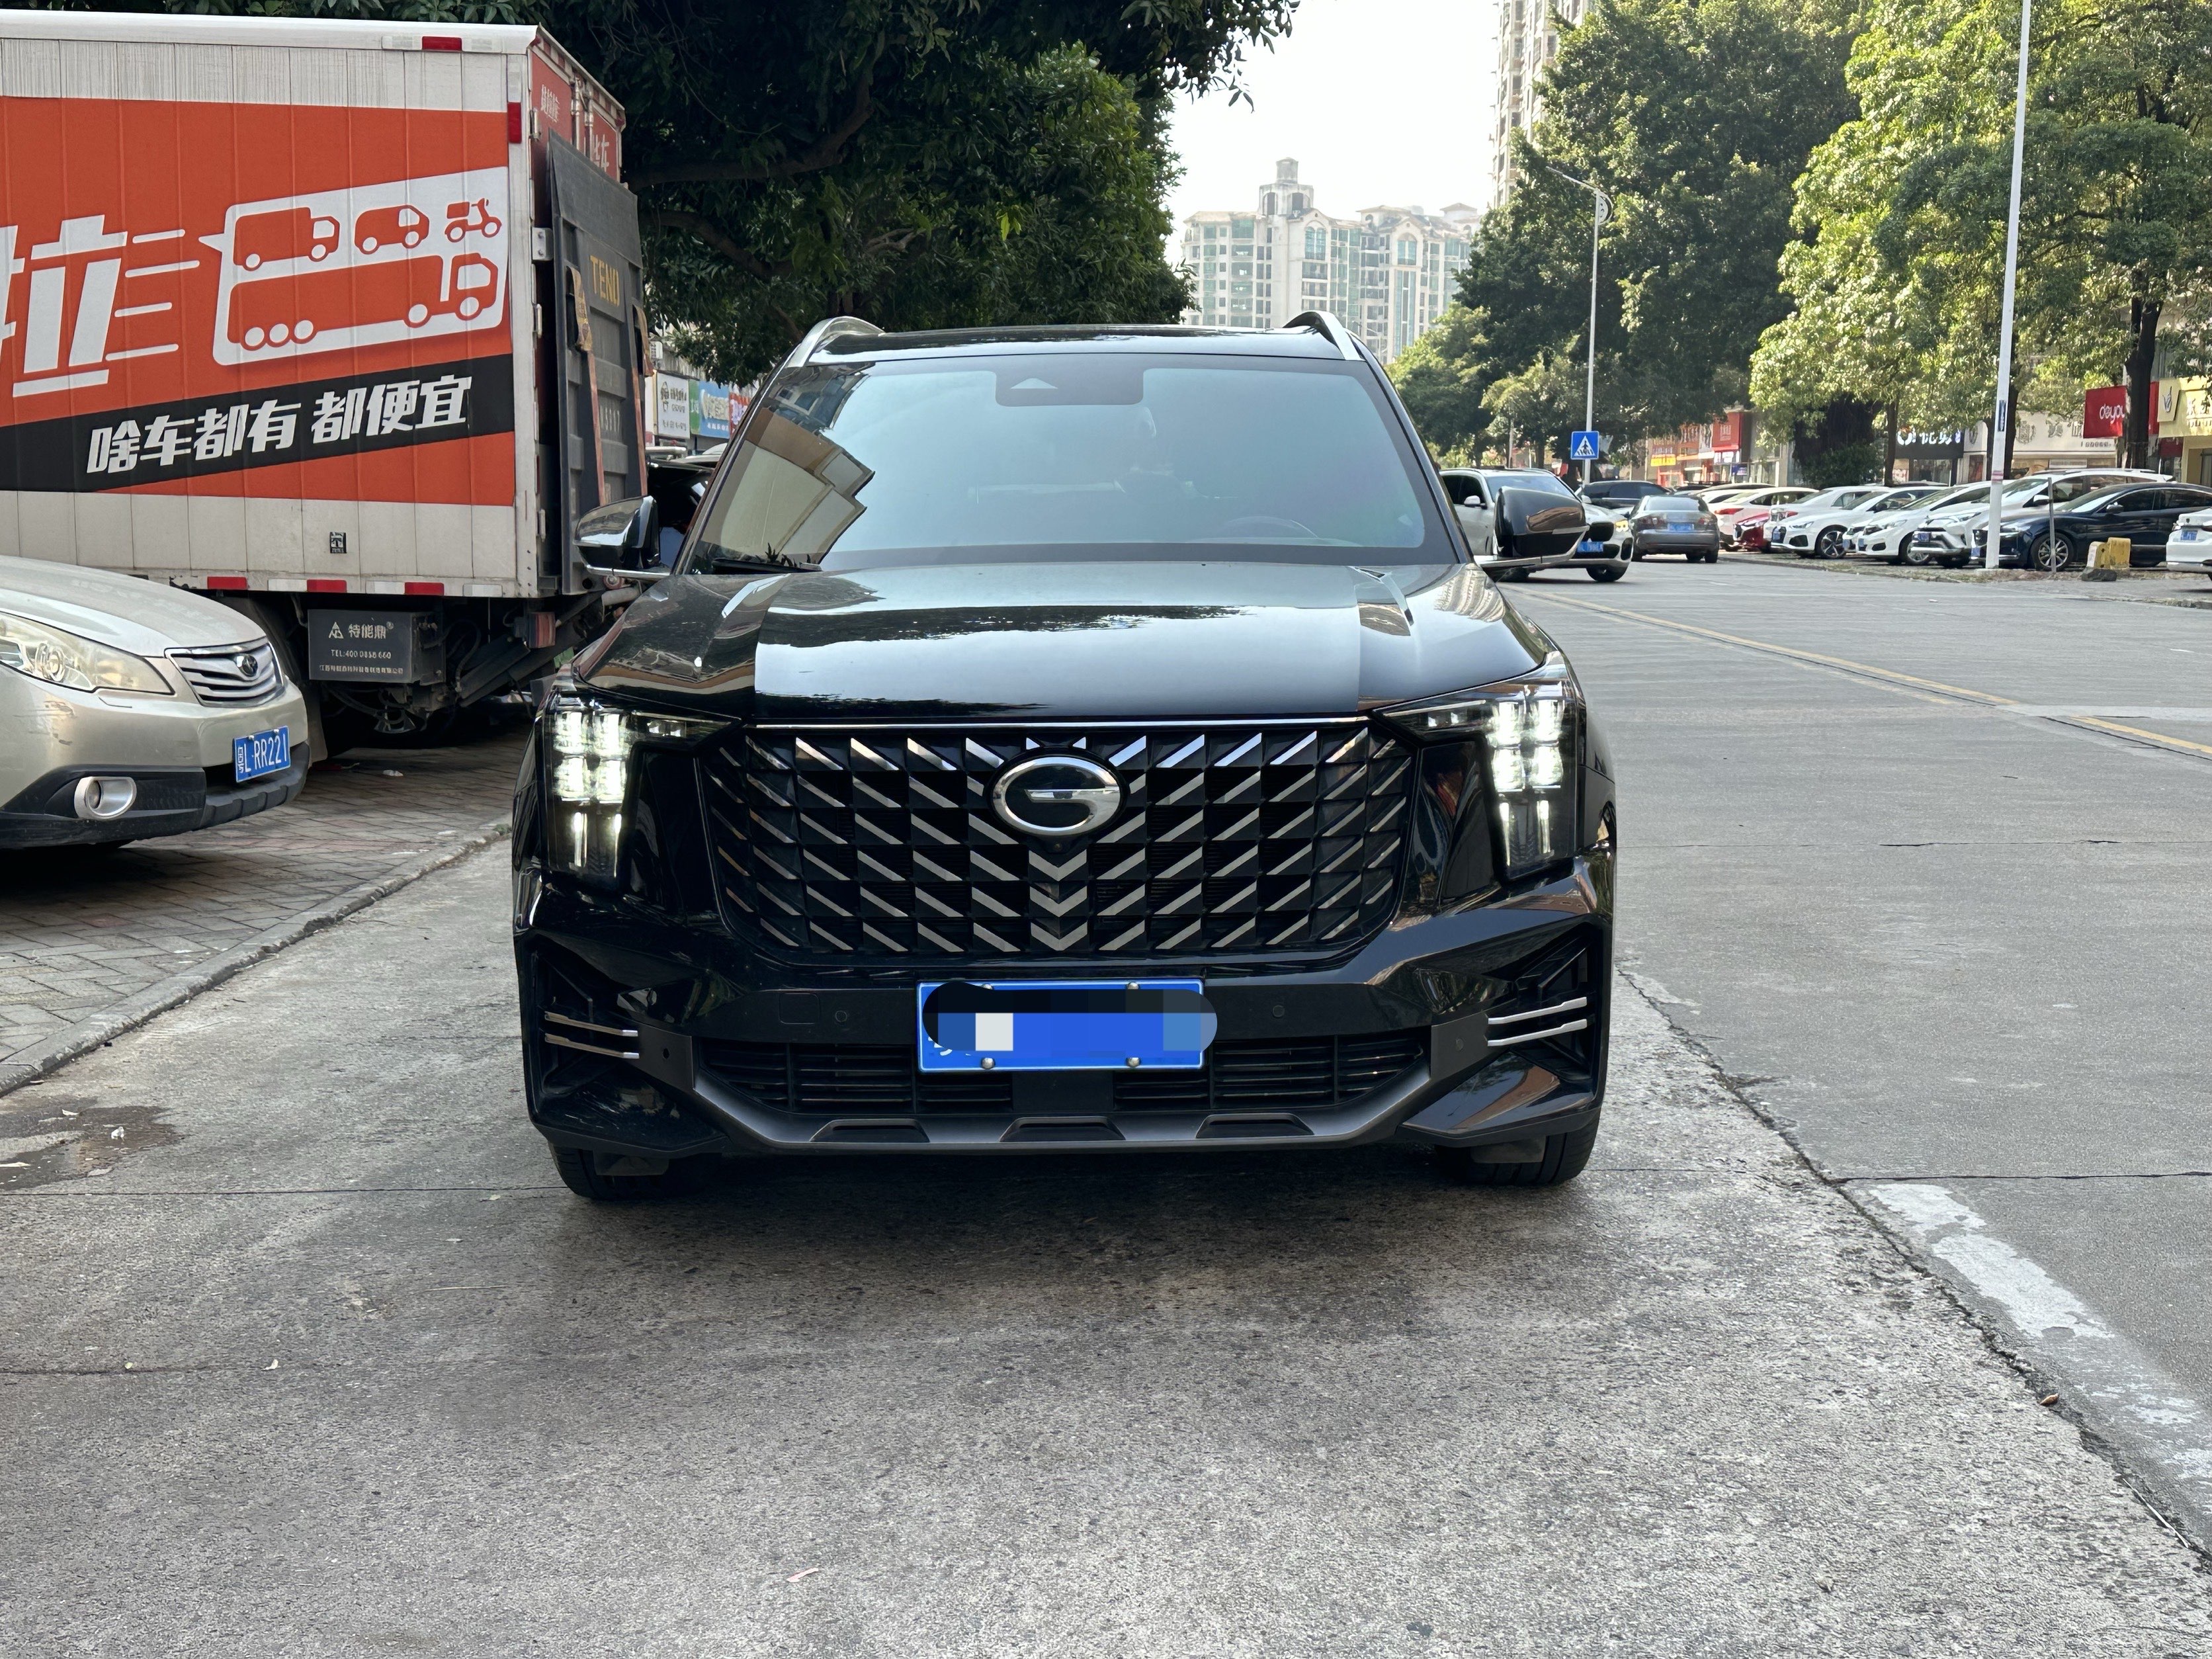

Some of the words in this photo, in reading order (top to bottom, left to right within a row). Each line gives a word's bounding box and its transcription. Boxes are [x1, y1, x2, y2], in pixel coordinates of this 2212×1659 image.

[86, 398, 302, 474] 啥车都有
[310, 374, 472, 445] 都便宜
